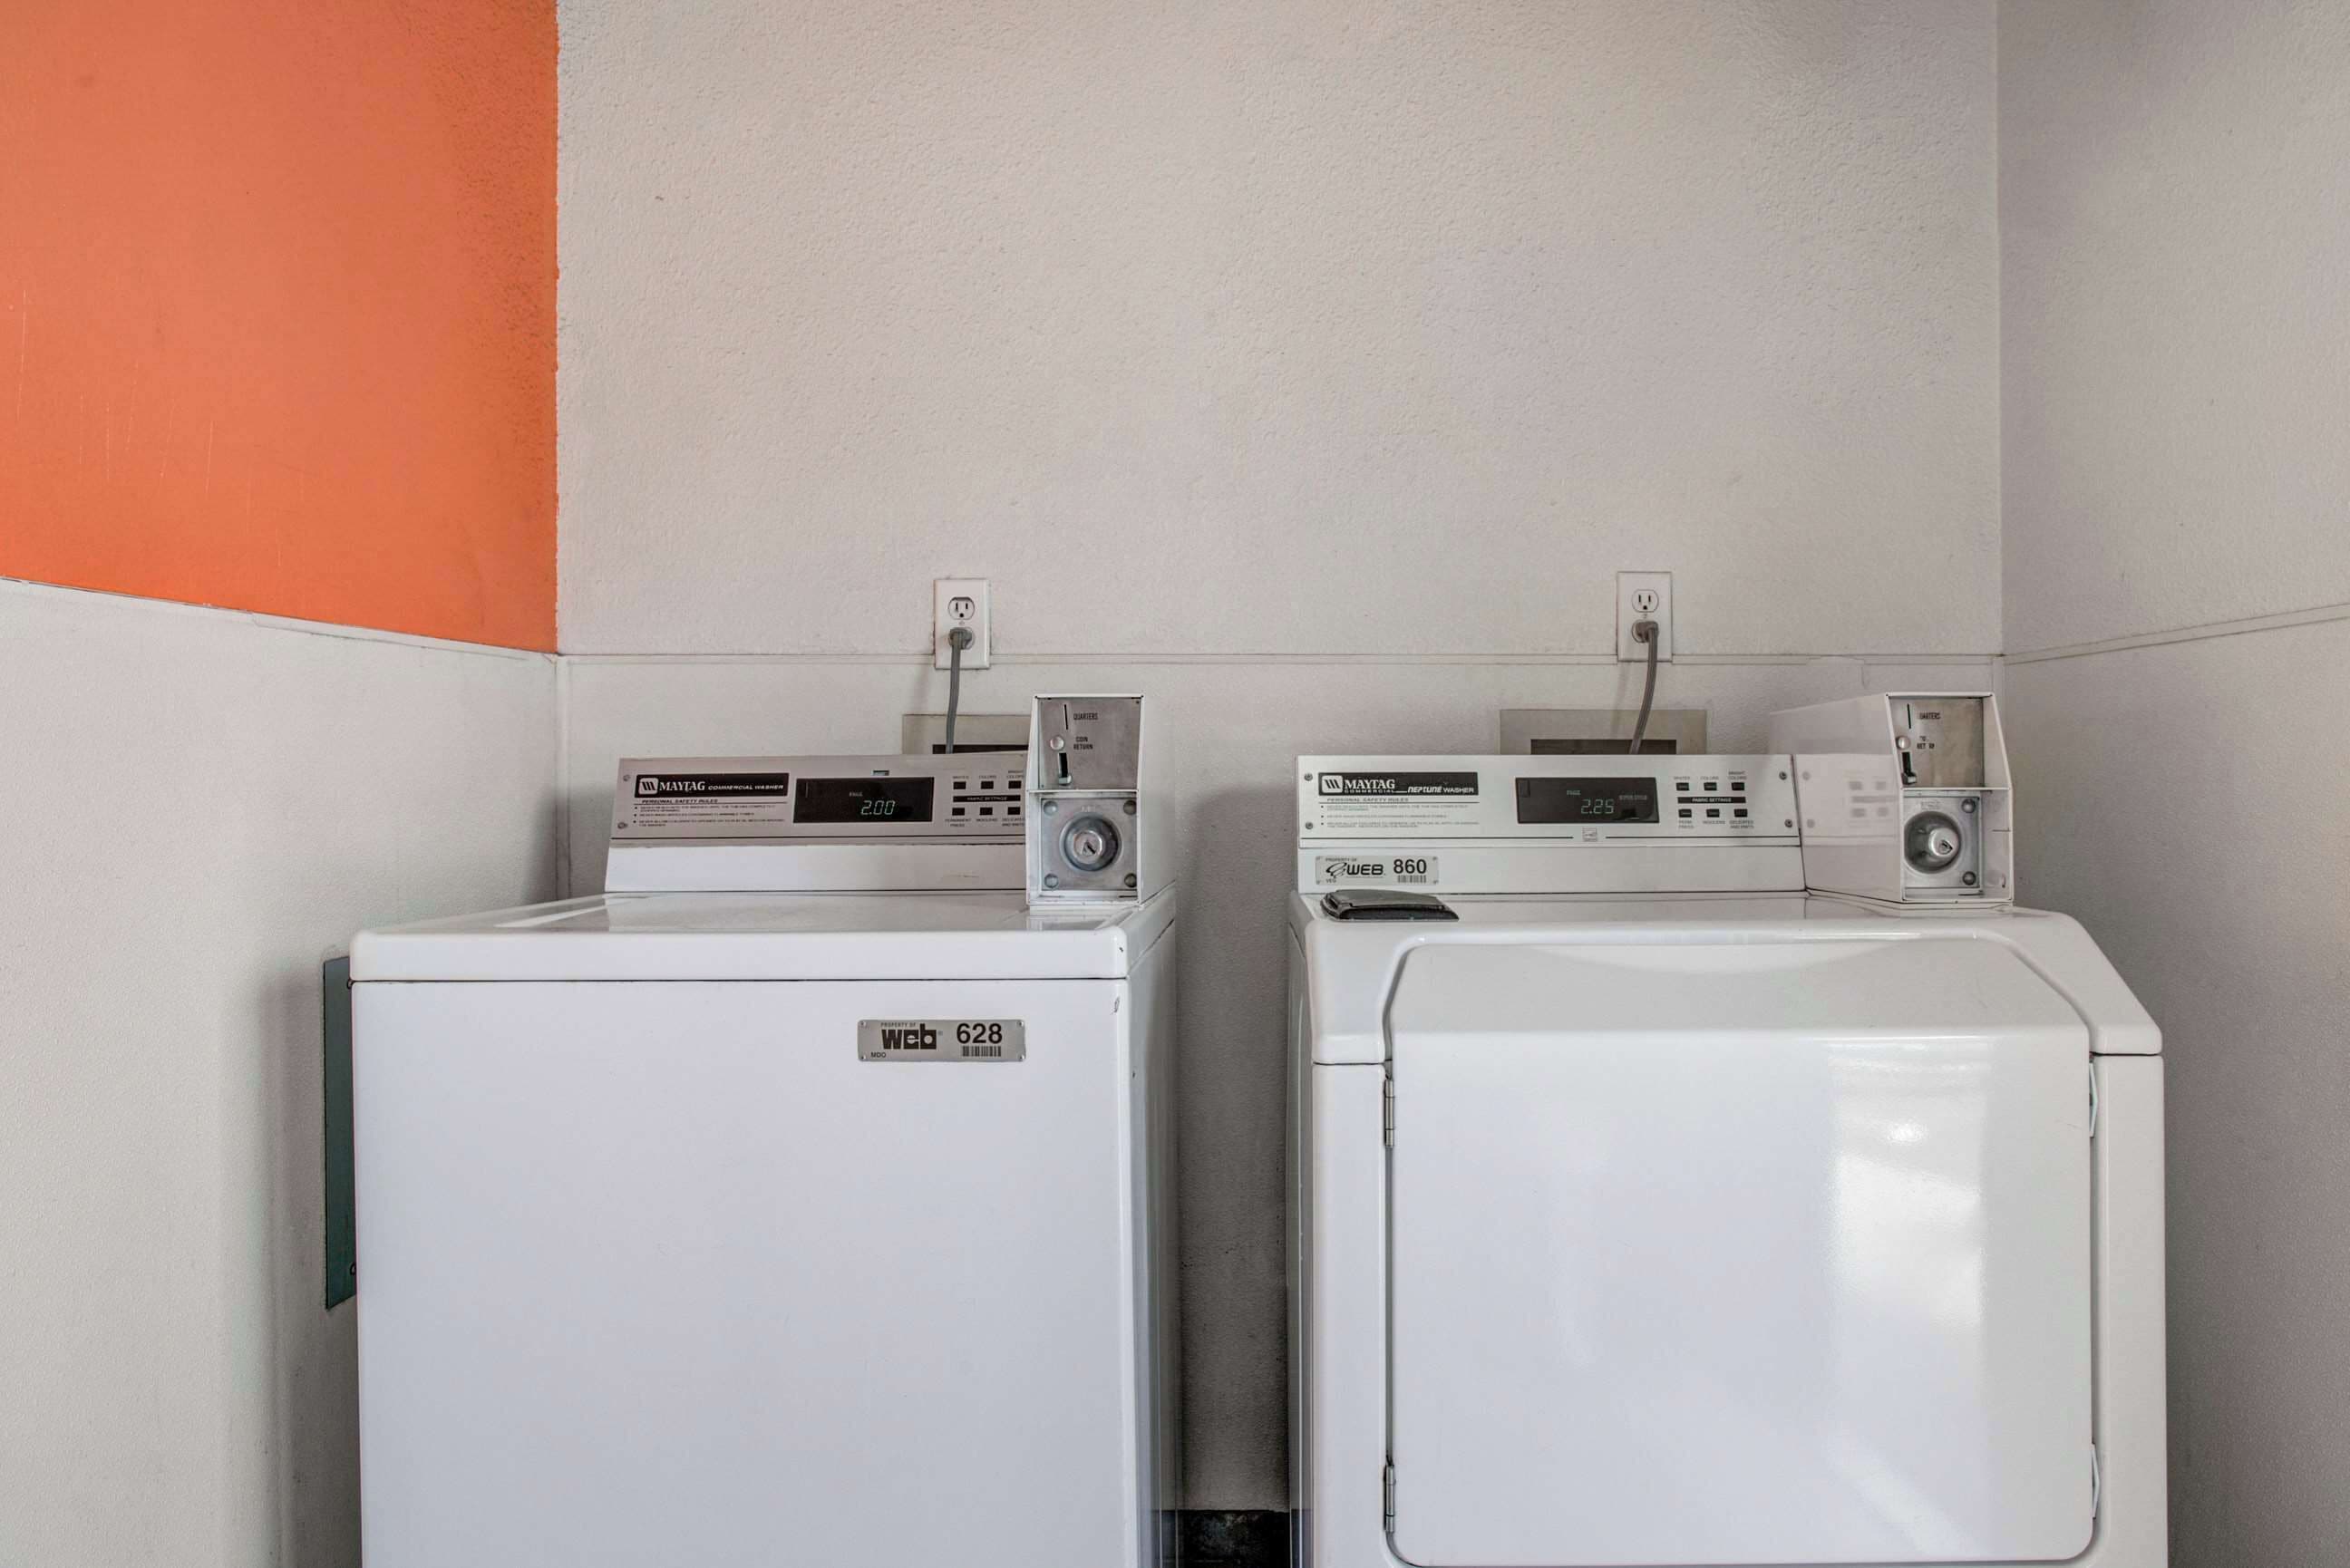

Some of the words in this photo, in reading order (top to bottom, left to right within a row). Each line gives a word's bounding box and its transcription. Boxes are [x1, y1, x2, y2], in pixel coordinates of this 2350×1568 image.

[659, 781, 705, 793] MAYTAG
[1344, 779, 1396, 789] MAYTAG
[860, 799, 896, 816] 2.00
[1580, 799, 1615, 815] 2.25
[1346, 864, 1384, 876] WEB
[1393, 858, 1427, 875] 860
[957, 1022, 1003, 1044] 628
